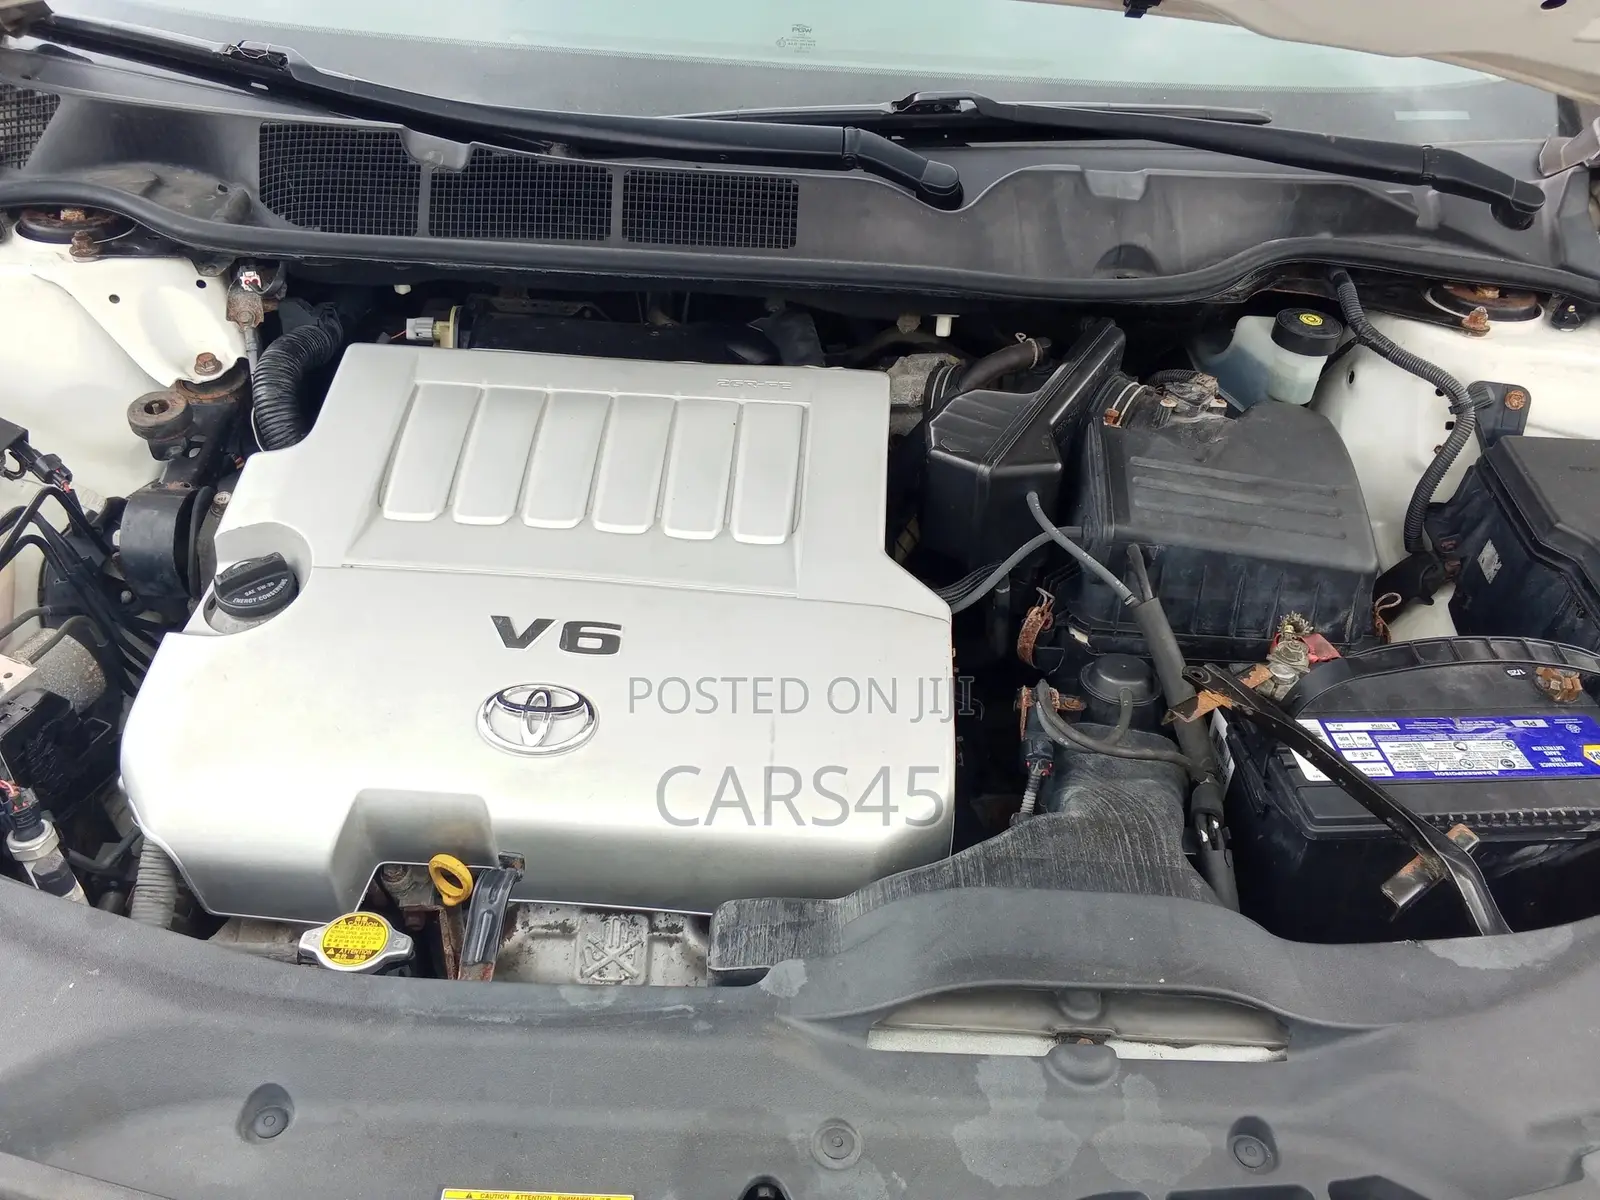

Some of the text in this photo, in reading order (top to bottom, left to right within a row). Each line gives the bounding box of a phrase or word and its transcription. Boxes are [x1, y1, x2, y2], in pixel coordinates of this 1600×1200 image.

[244, 589, 256, 597] SAE
[258, 578, 288, 601] CONSERVING
[490, 615, 622, 655] V6
